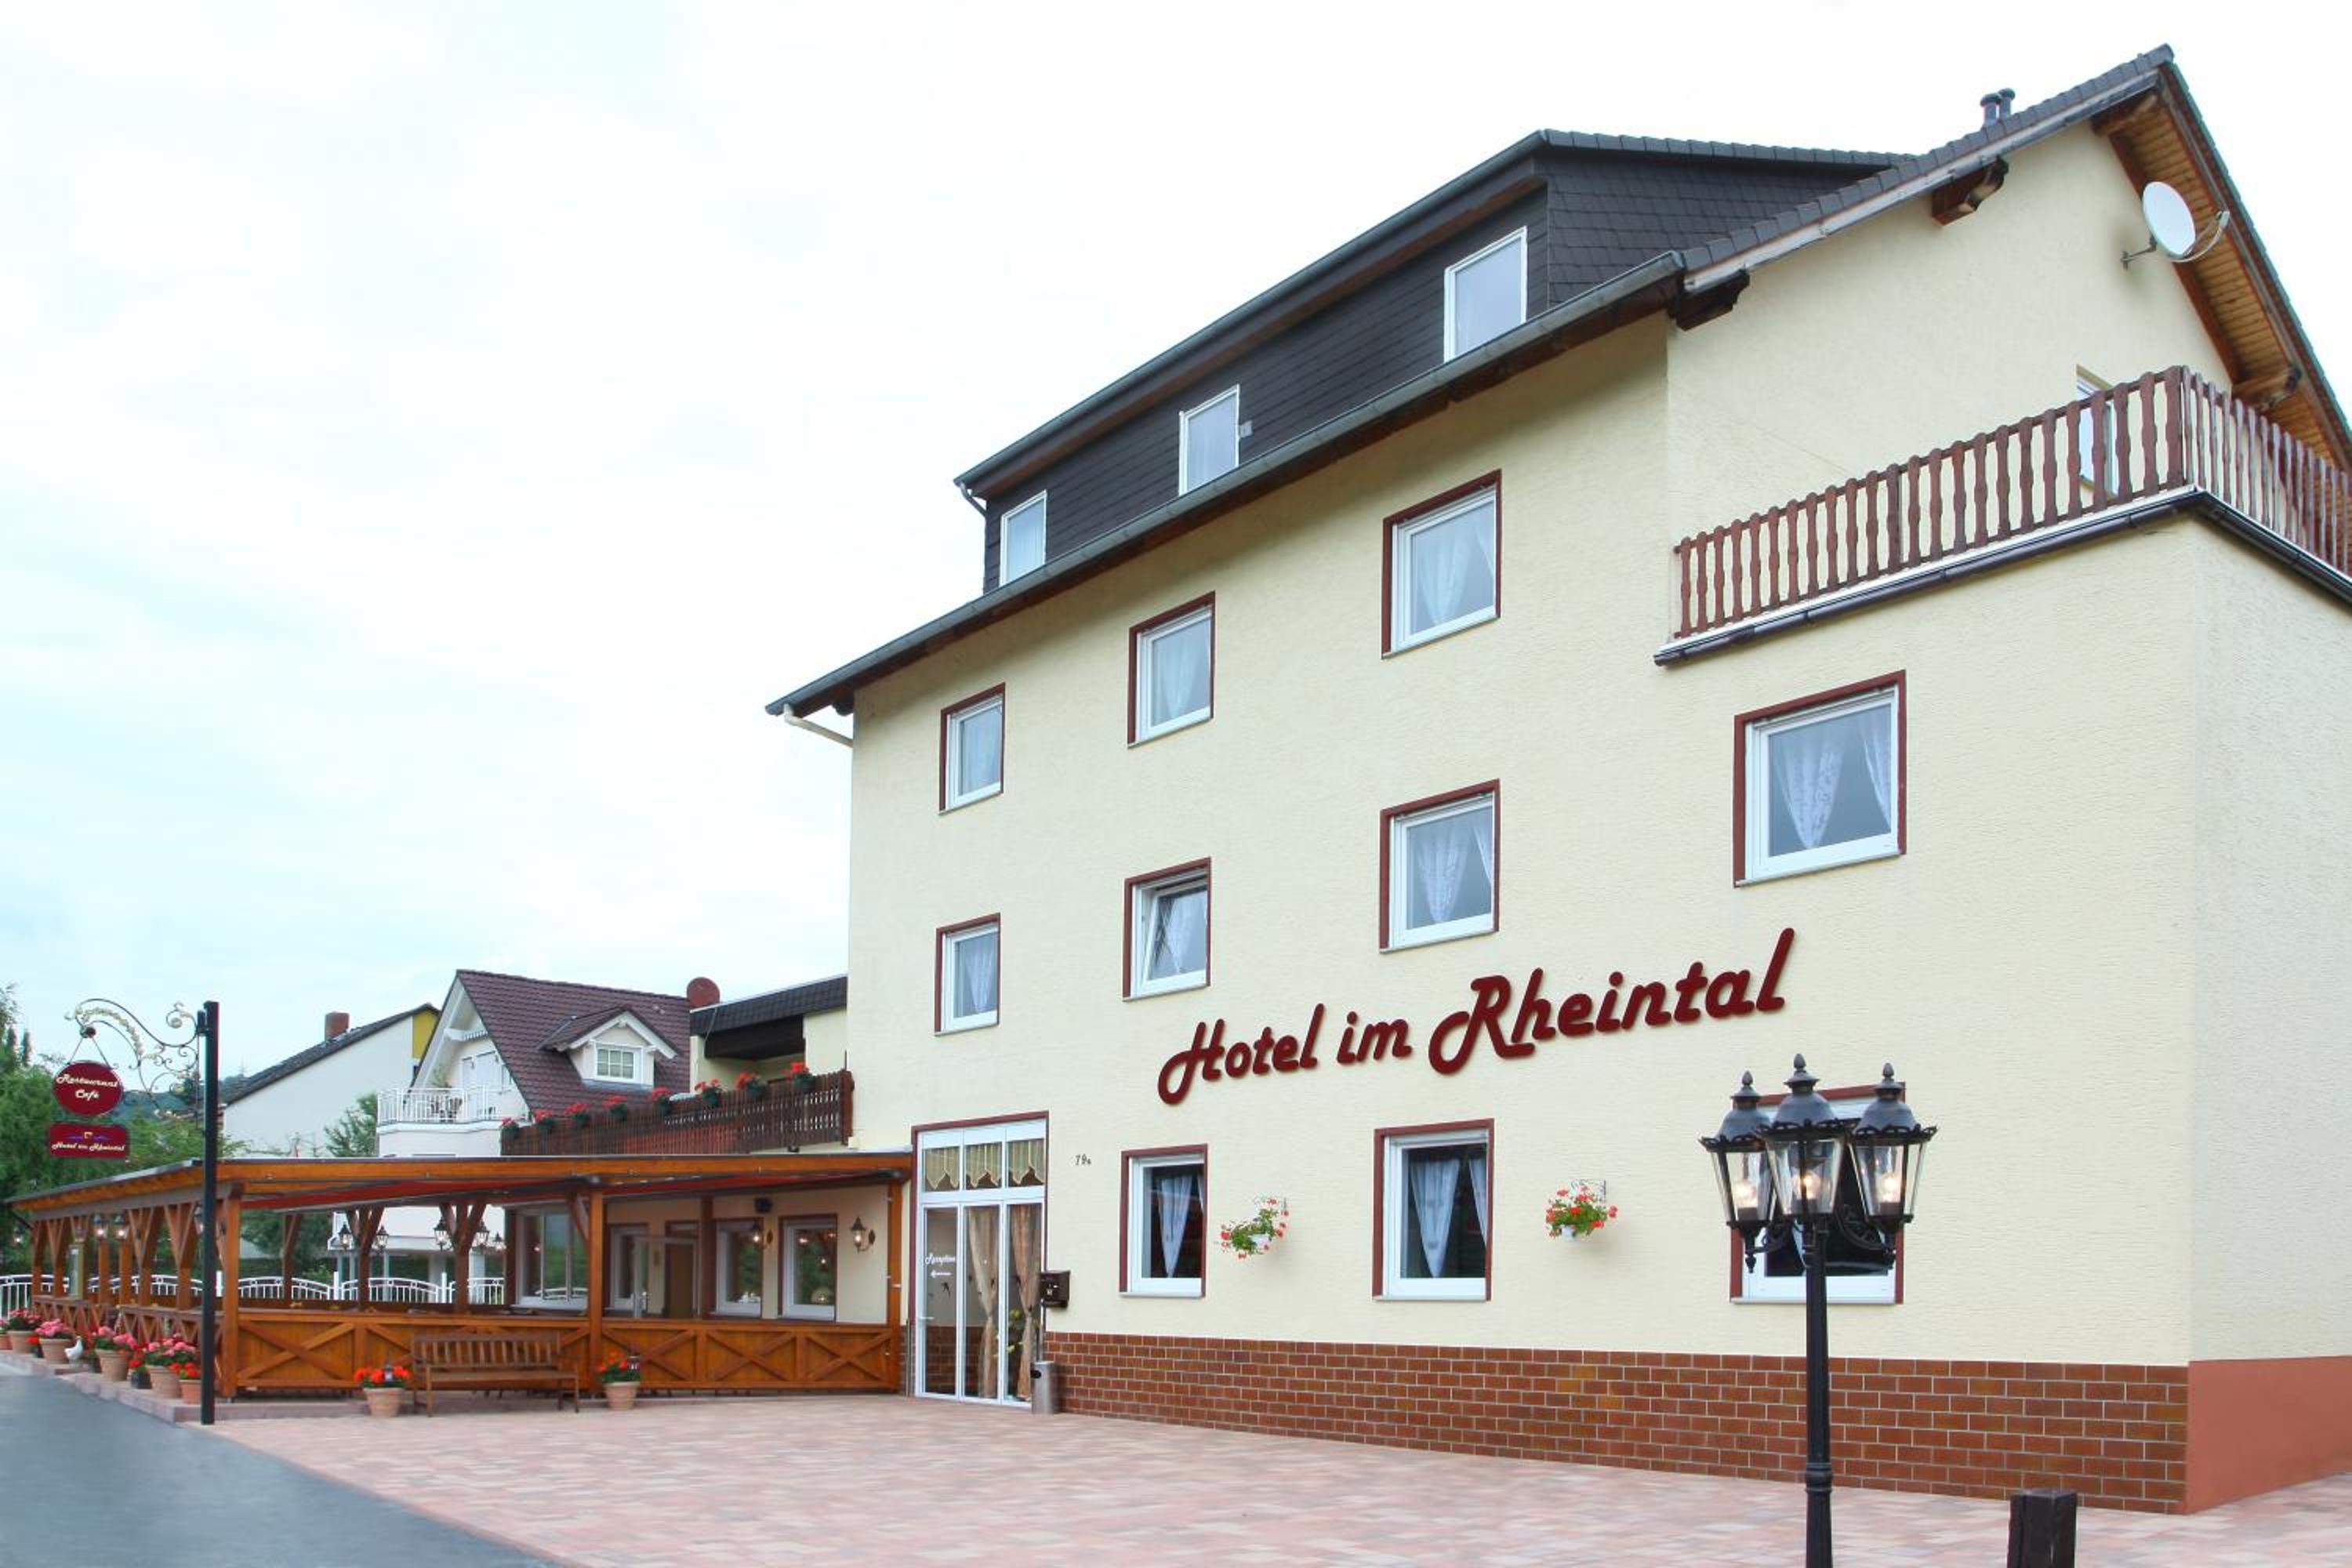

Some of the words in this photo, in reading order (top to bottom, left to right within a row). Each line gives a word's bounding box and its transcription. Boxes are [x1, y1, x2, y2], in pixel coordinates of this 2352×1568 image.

[1158, 1004, 1325, 1105] Hotel
[1337, 1011, 1412, 1065] im
[1428, 927, 1795, 1075] Rheintal
[56, 1073, 118, 1087] Restaurant
